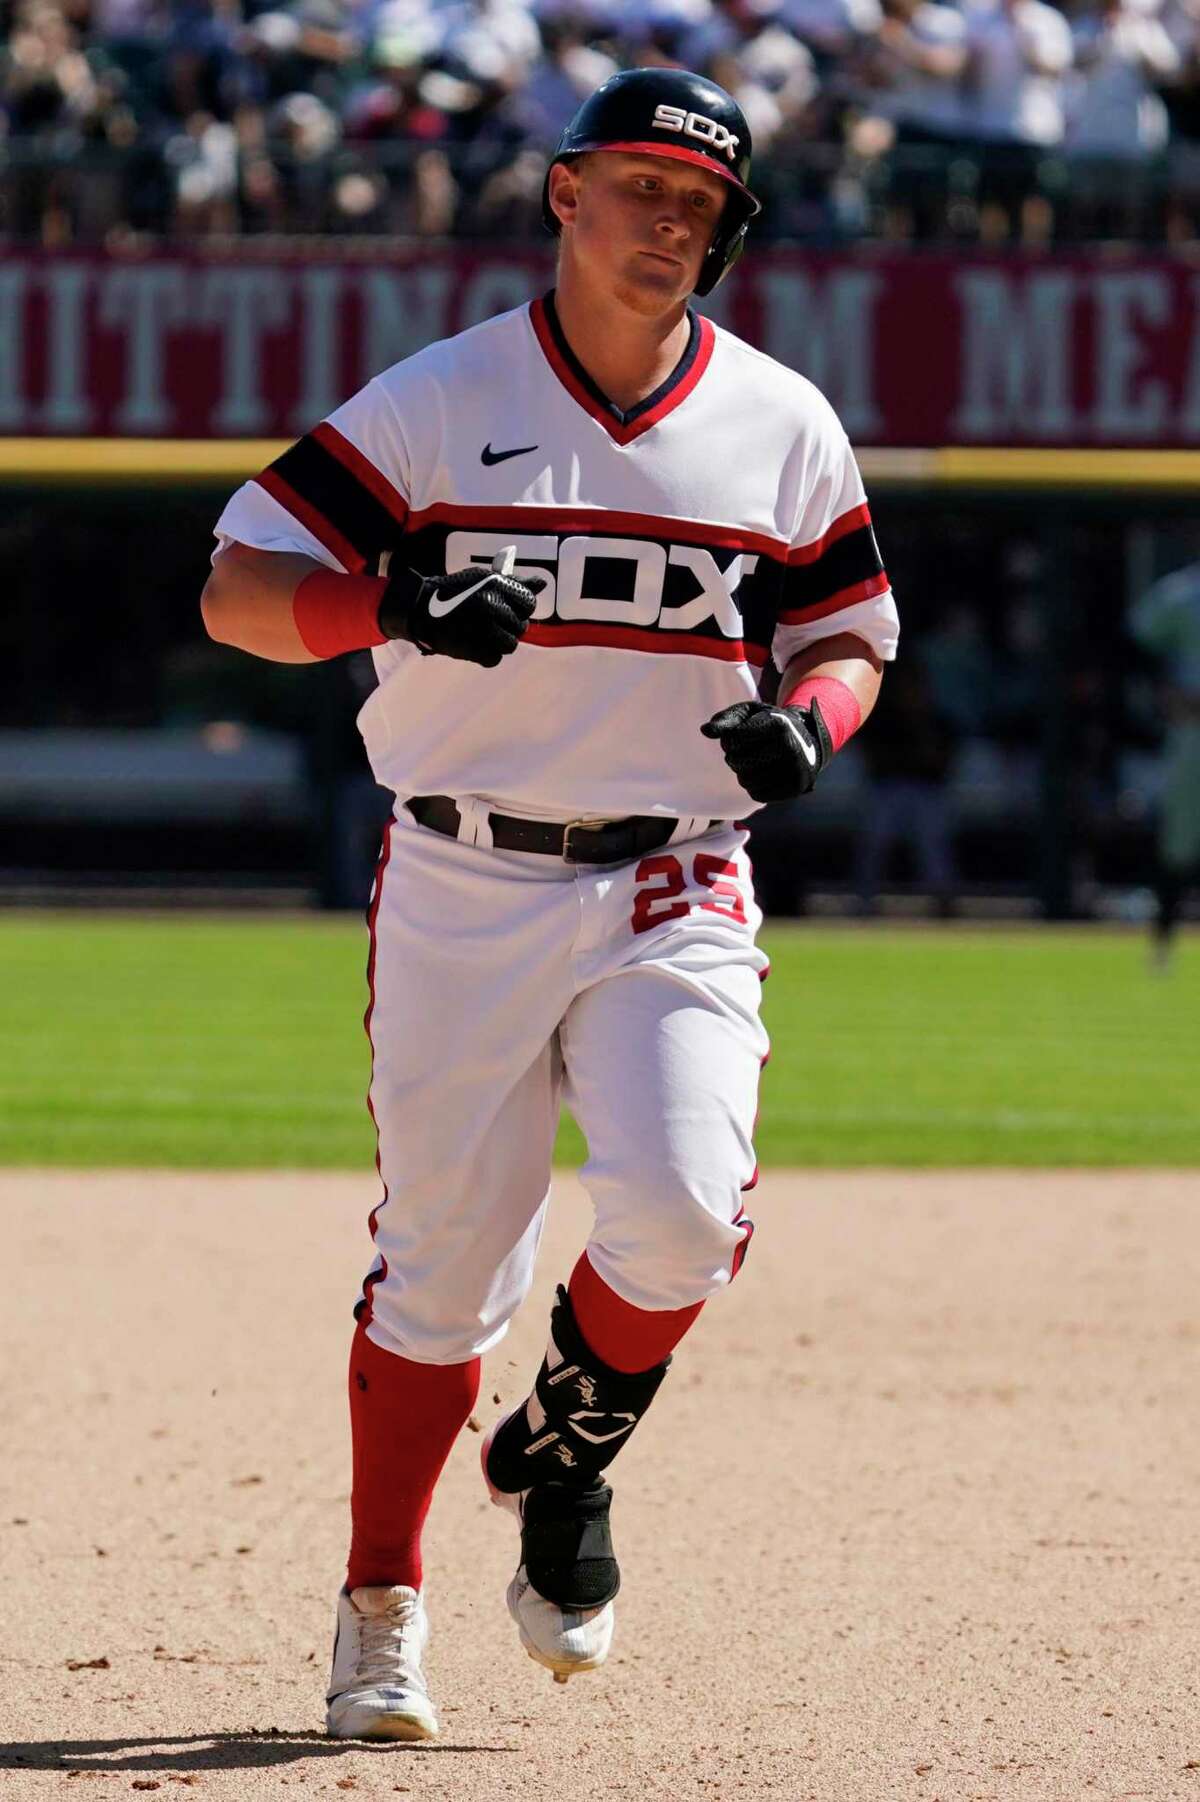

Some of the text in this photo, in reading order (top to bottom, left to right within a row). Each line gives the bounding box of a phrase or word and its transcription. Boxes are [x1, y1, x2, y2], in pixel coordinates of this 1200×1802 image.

[652, 104, 740, 160] SOX
[954, 270, 1200, 434] ME
[445, 531, 759, 639] SOX
[631, 853, 748, 934] 25
